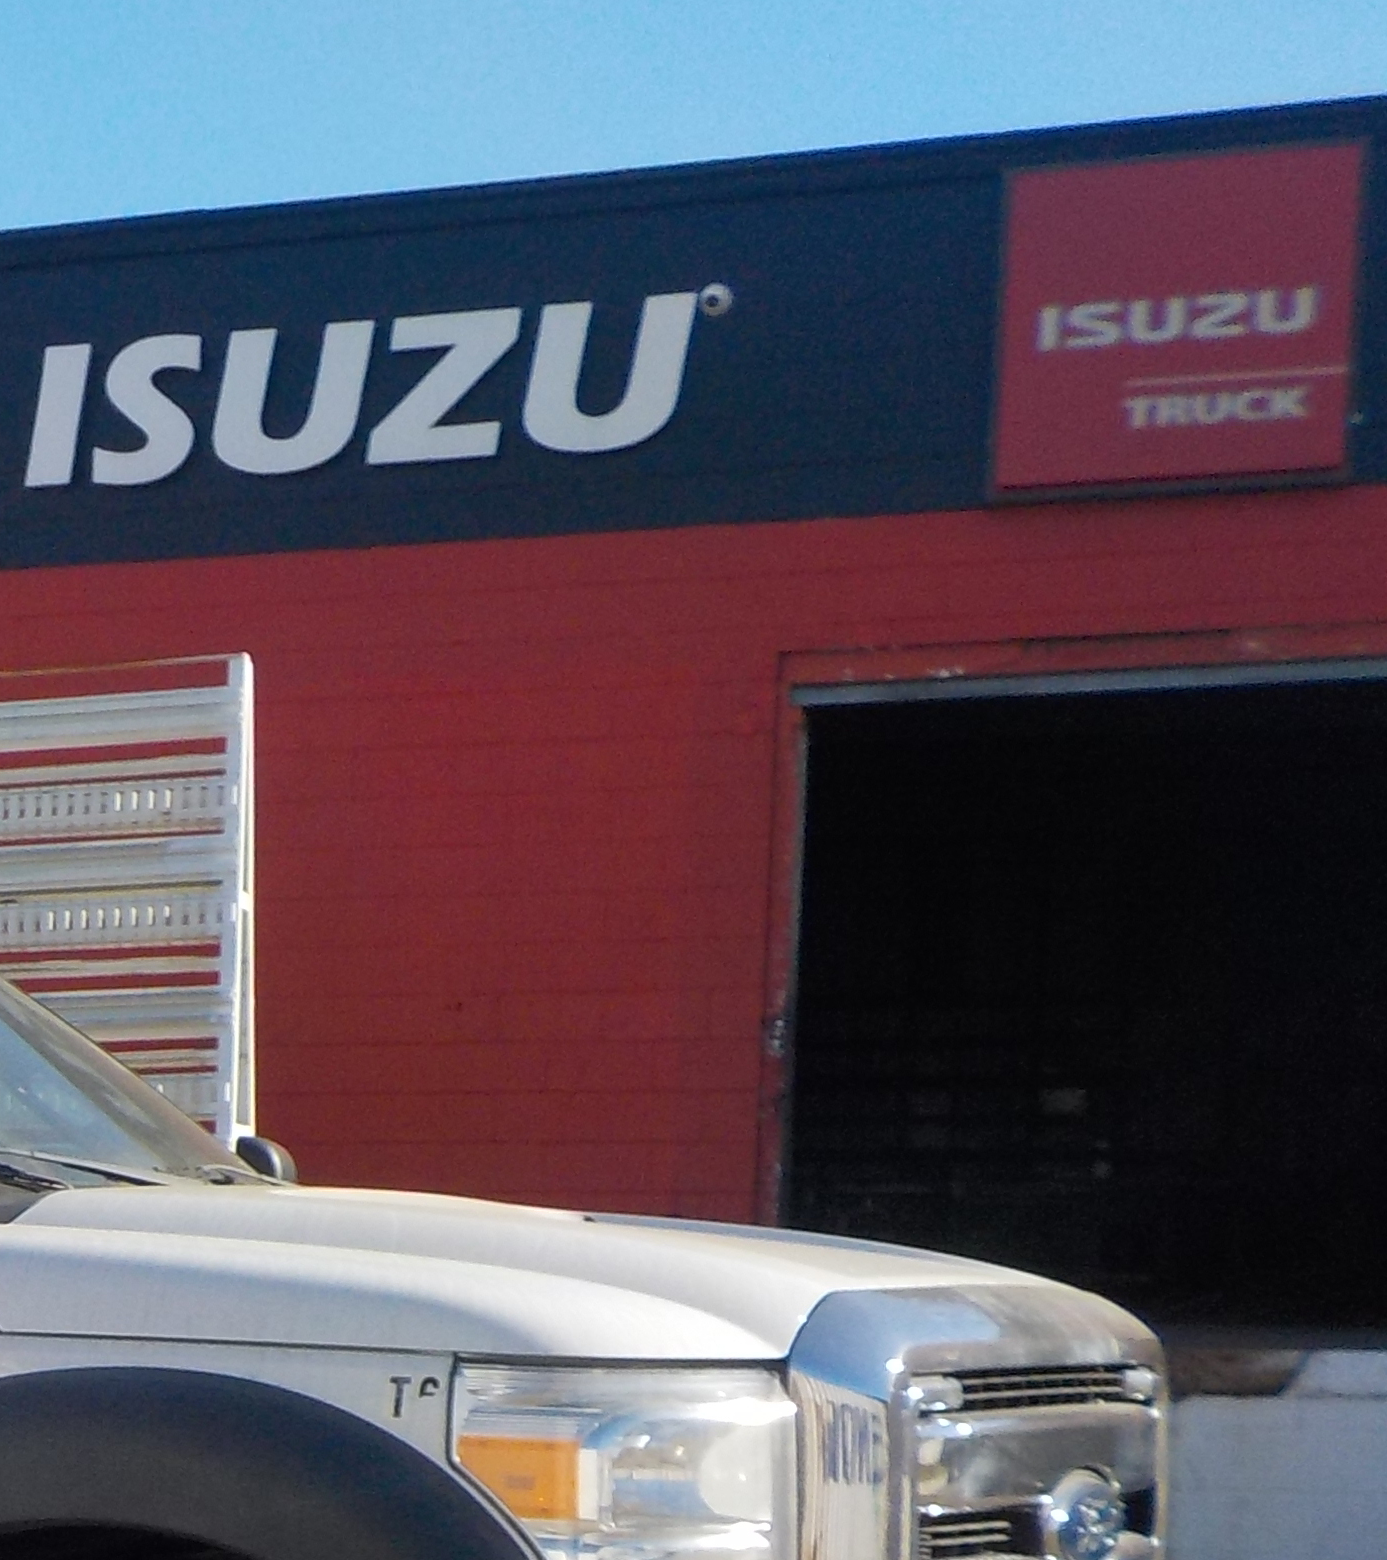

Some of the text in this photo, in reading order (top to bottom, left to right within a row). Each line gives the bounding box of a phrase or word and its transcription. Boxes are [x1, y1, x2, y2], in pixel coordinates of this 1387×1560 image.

[1037, 286, 1318, 353] ISUZU
[24, 289, 699, 488] ISUZU
[1124, 388, 1310, 429] TRUCK
